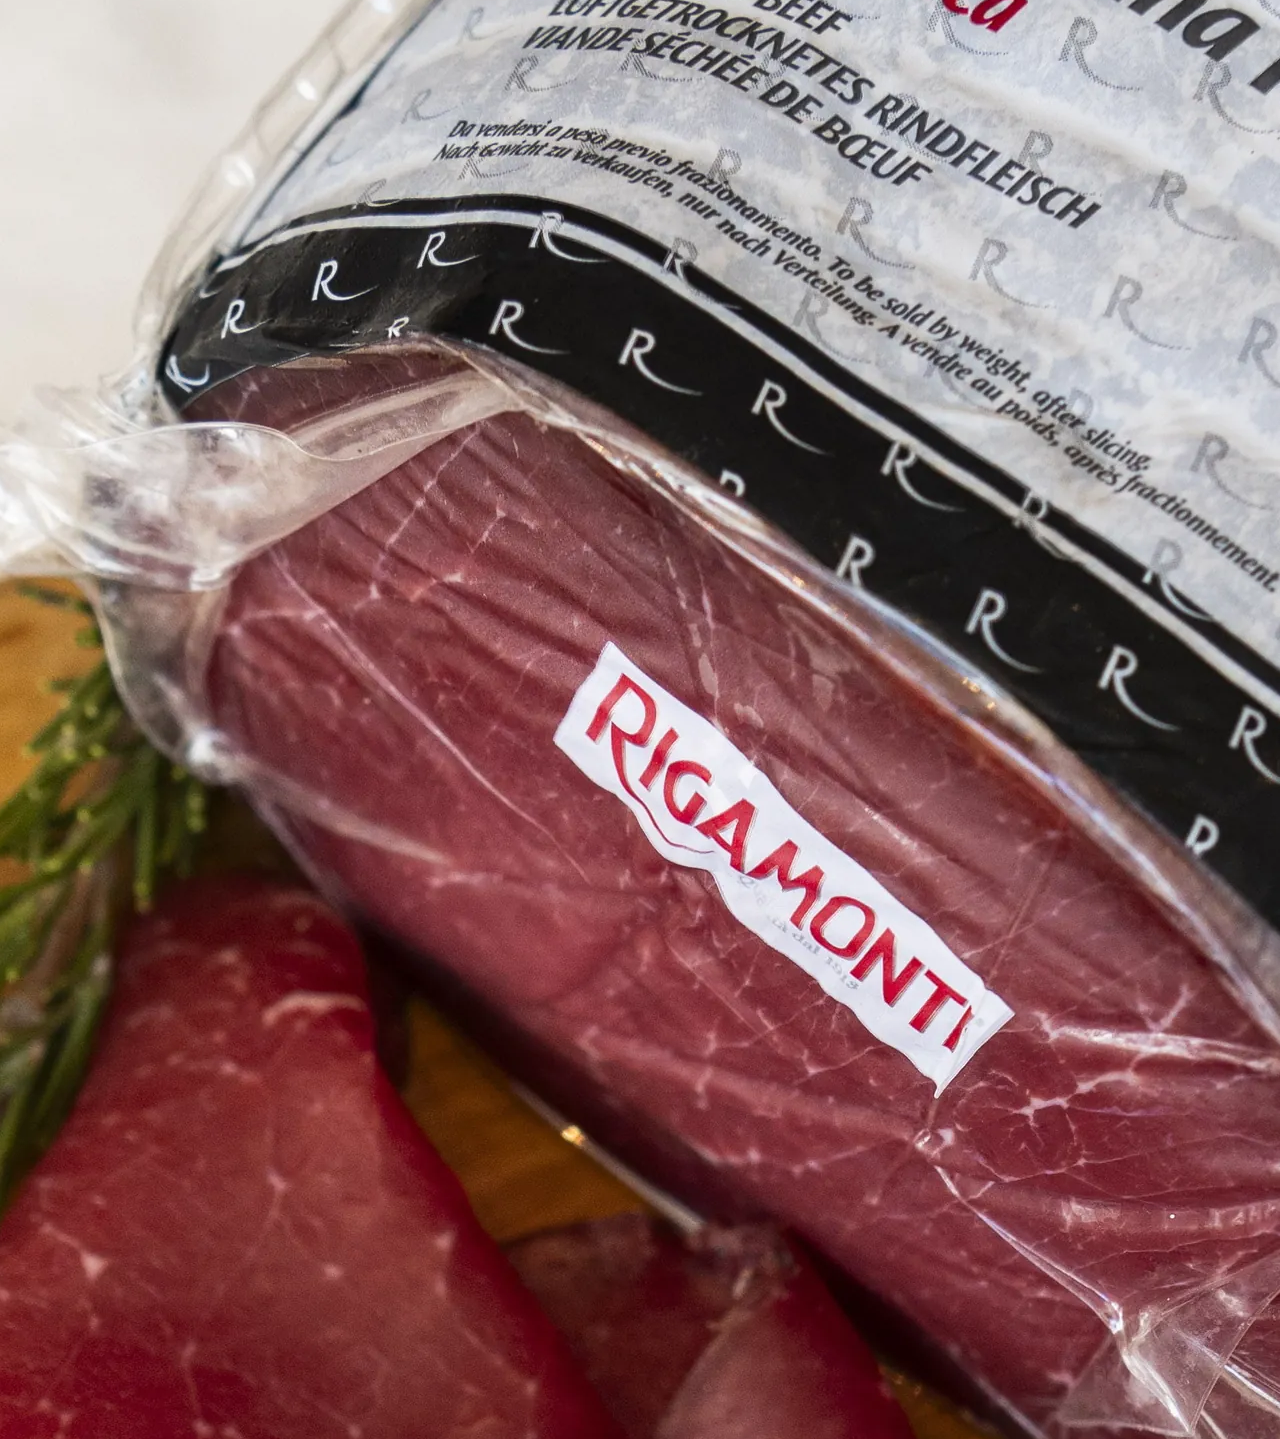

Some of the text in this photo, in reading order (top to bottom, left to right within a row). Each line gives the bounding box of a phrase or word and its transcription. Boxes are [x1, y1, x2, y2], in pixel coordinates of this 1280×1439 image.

[524, 27, 937, 189] VIANDE SÉCHÉE DE BŒUF
[865, 92, 1101, 228] RINDFLEISCH
[434, 141, 1279, 593] Nach Gewicht zu verkaufen, nur nach Verteilung. A vendre au poids, après fractionnement.
[448, 120, 1152, 471] Da vendersi a peso previo frazionamento. To be sold by weight, after slicing.
[585, 673, 975, 1052] RIGAMONTI
